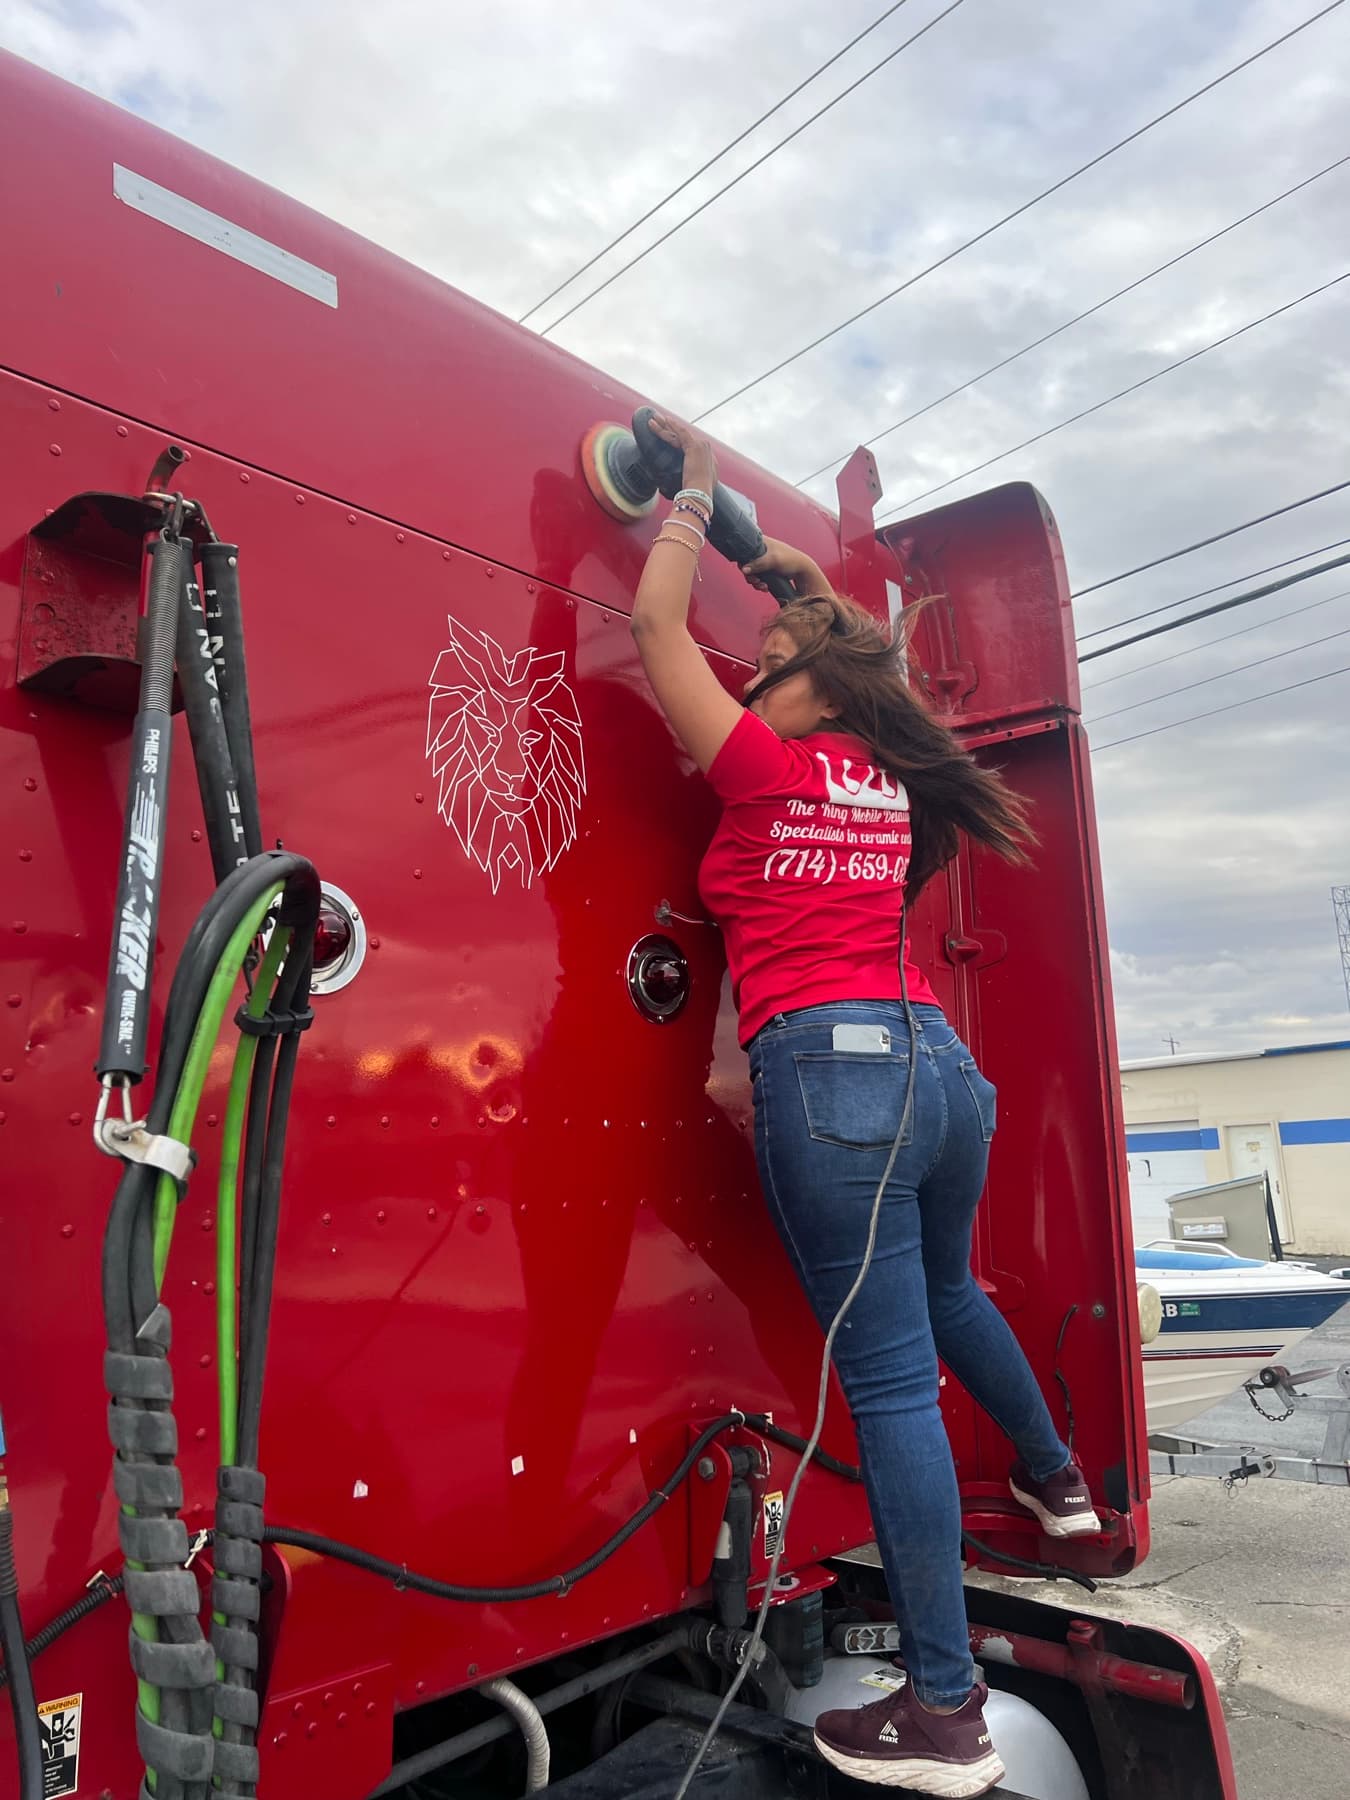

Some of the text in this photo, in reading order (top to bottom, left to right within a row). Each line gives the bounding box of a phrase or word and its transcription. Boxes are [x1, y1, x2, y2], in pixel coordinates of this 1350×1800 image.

[142, 728, 161, 774] PHILLIPS
[786, 799, 816, 816] The
[821, 802, 848, 825] King
[851, 807, 882, 823] Mobile
[770, 821, 845, 842] Specialists
[847, 828, 858, 843] in
[860, 829, 899, 844] ceramic
[117, 988, 138, 1048] QWIK-SNA
[46, 1697, 78, 1713] WARNING
